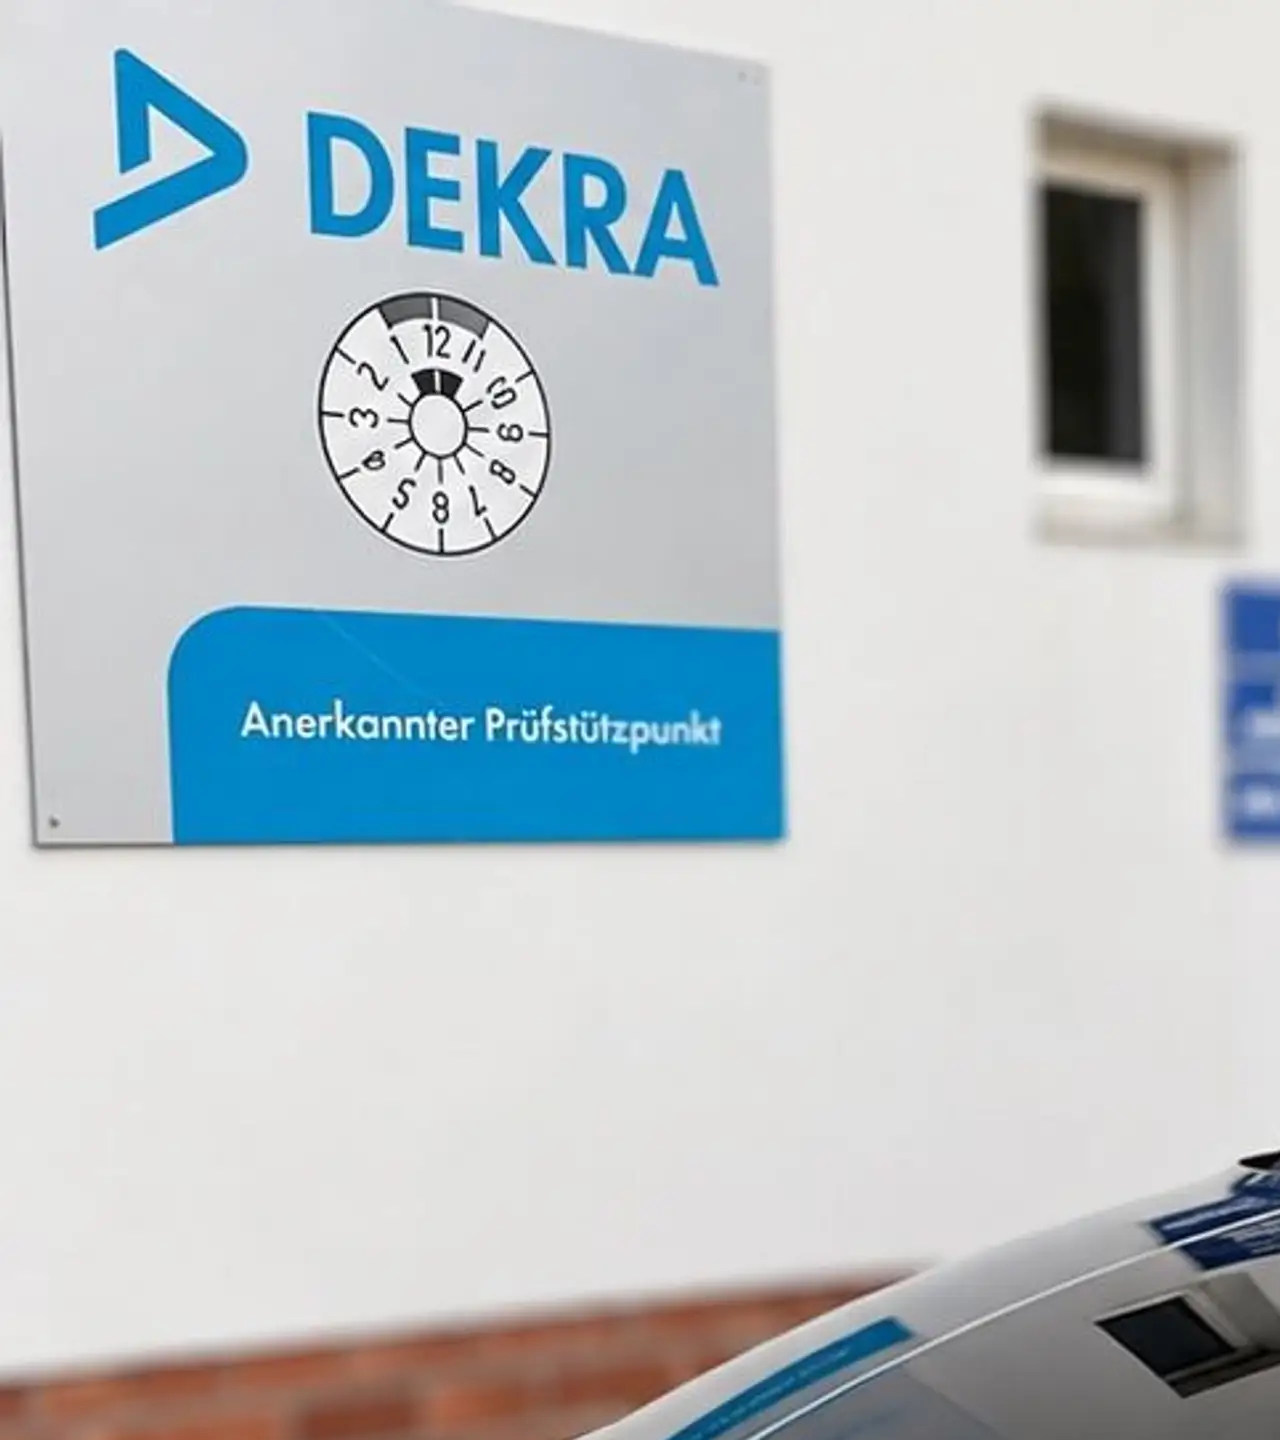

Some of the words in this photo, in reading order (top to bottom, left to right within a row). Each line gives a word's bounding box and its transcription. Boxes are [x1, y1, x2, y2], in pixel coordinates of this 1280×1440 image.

[304, 111, 719, 288] DEKRA
[389, 335, 410, 365] 1
[423, 323, 451, 359] 12
[357, 361, 389, 392] 2
[348, 407, 379, 429] 3
[489, 459, 516, 485] 8
[468, 485, 487, 517] 7
[240, 699, 475, 742] Anerkannter
[485, 705, 722, 755] Prüfstützpunkt
